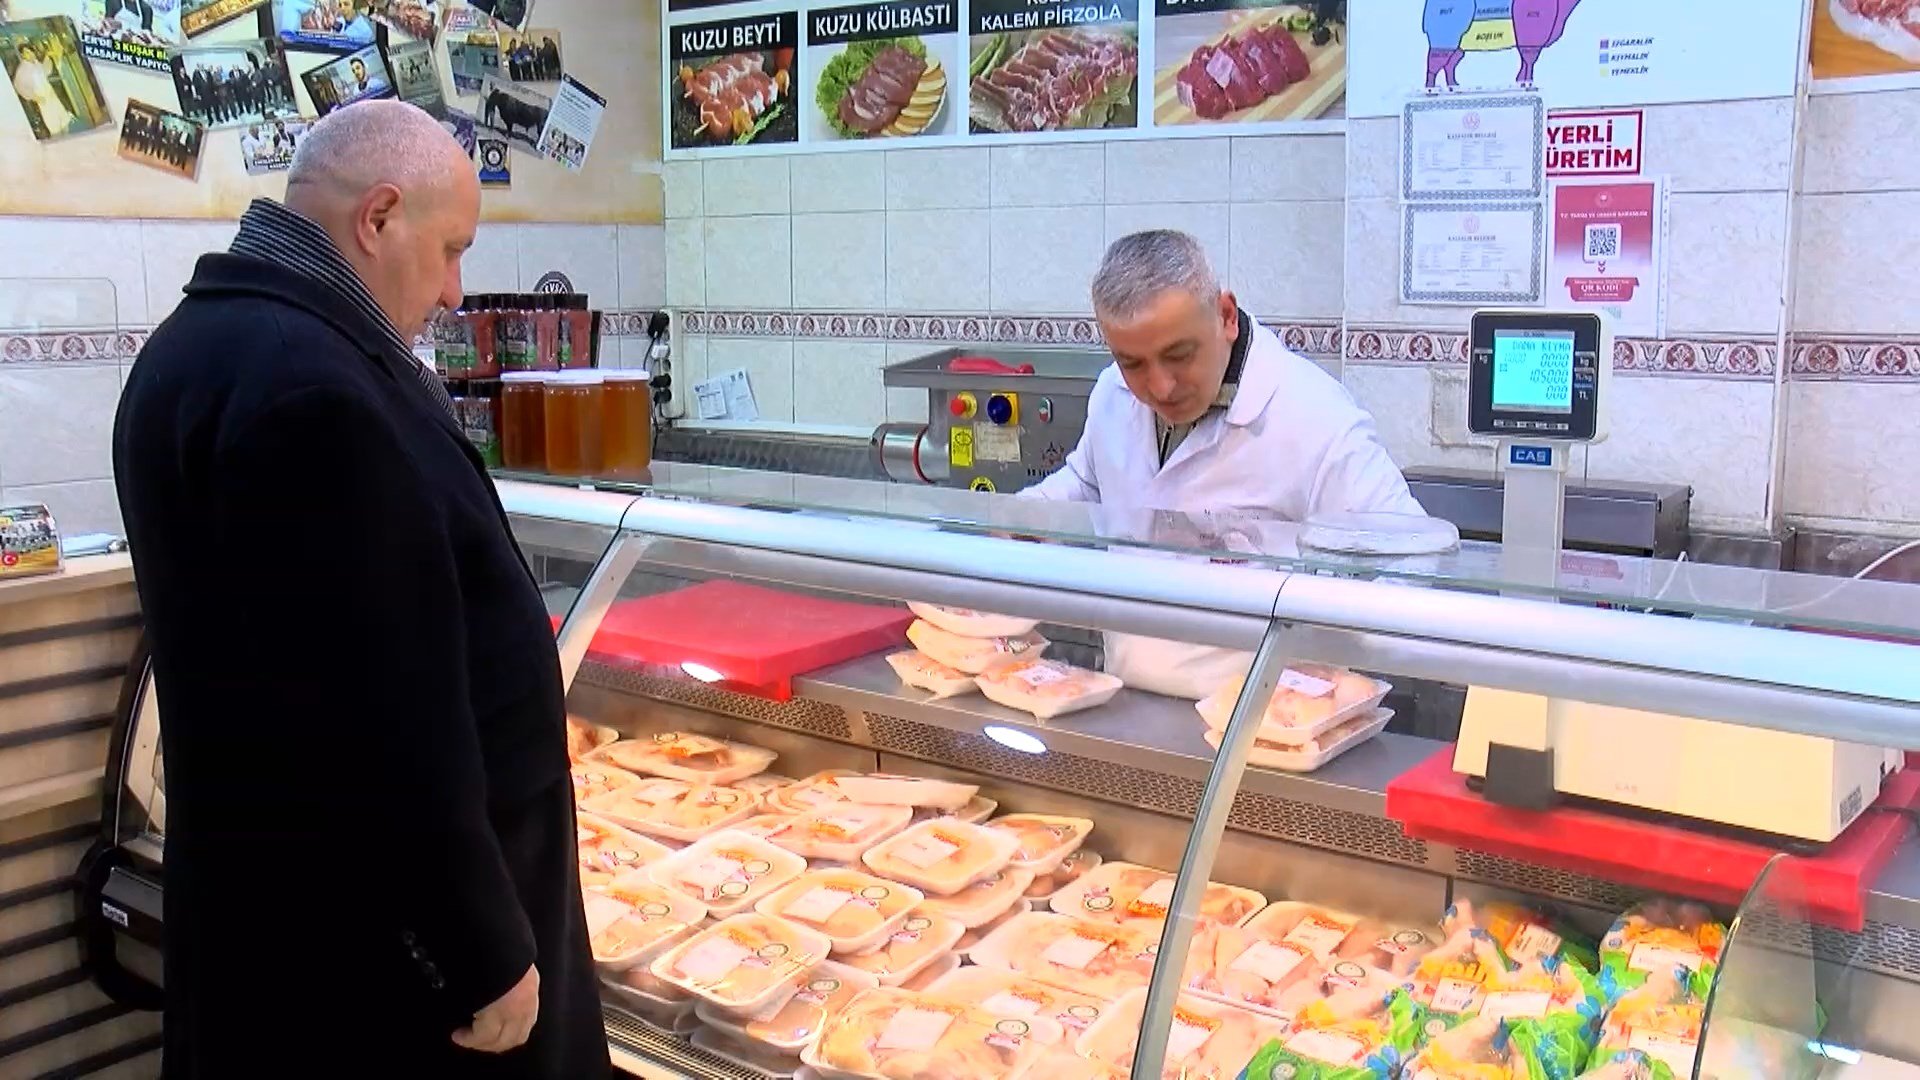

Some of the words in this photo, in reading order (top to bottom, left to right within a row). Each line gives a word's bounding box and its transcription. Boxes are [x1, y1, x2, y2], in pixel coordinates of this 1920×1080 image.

[815, 16, 861, 37] KUZU
[866, 4, 951, 32] KÜLBASTI
[980, 11, 1039, 31] KALEM
[1044, 3, 1122, 26] PİRZOLA
[681, 28, 728, 53] KUZU
[733, 16, 781, 47] BEYTİ
[85, 46, 133, 64] KASAPLIK
[1547, 119, 1613, 144] YERLİ
[1546, 145, 1633, 168] ÜRETİM
[1515, 450, 1546, 462] CAS
